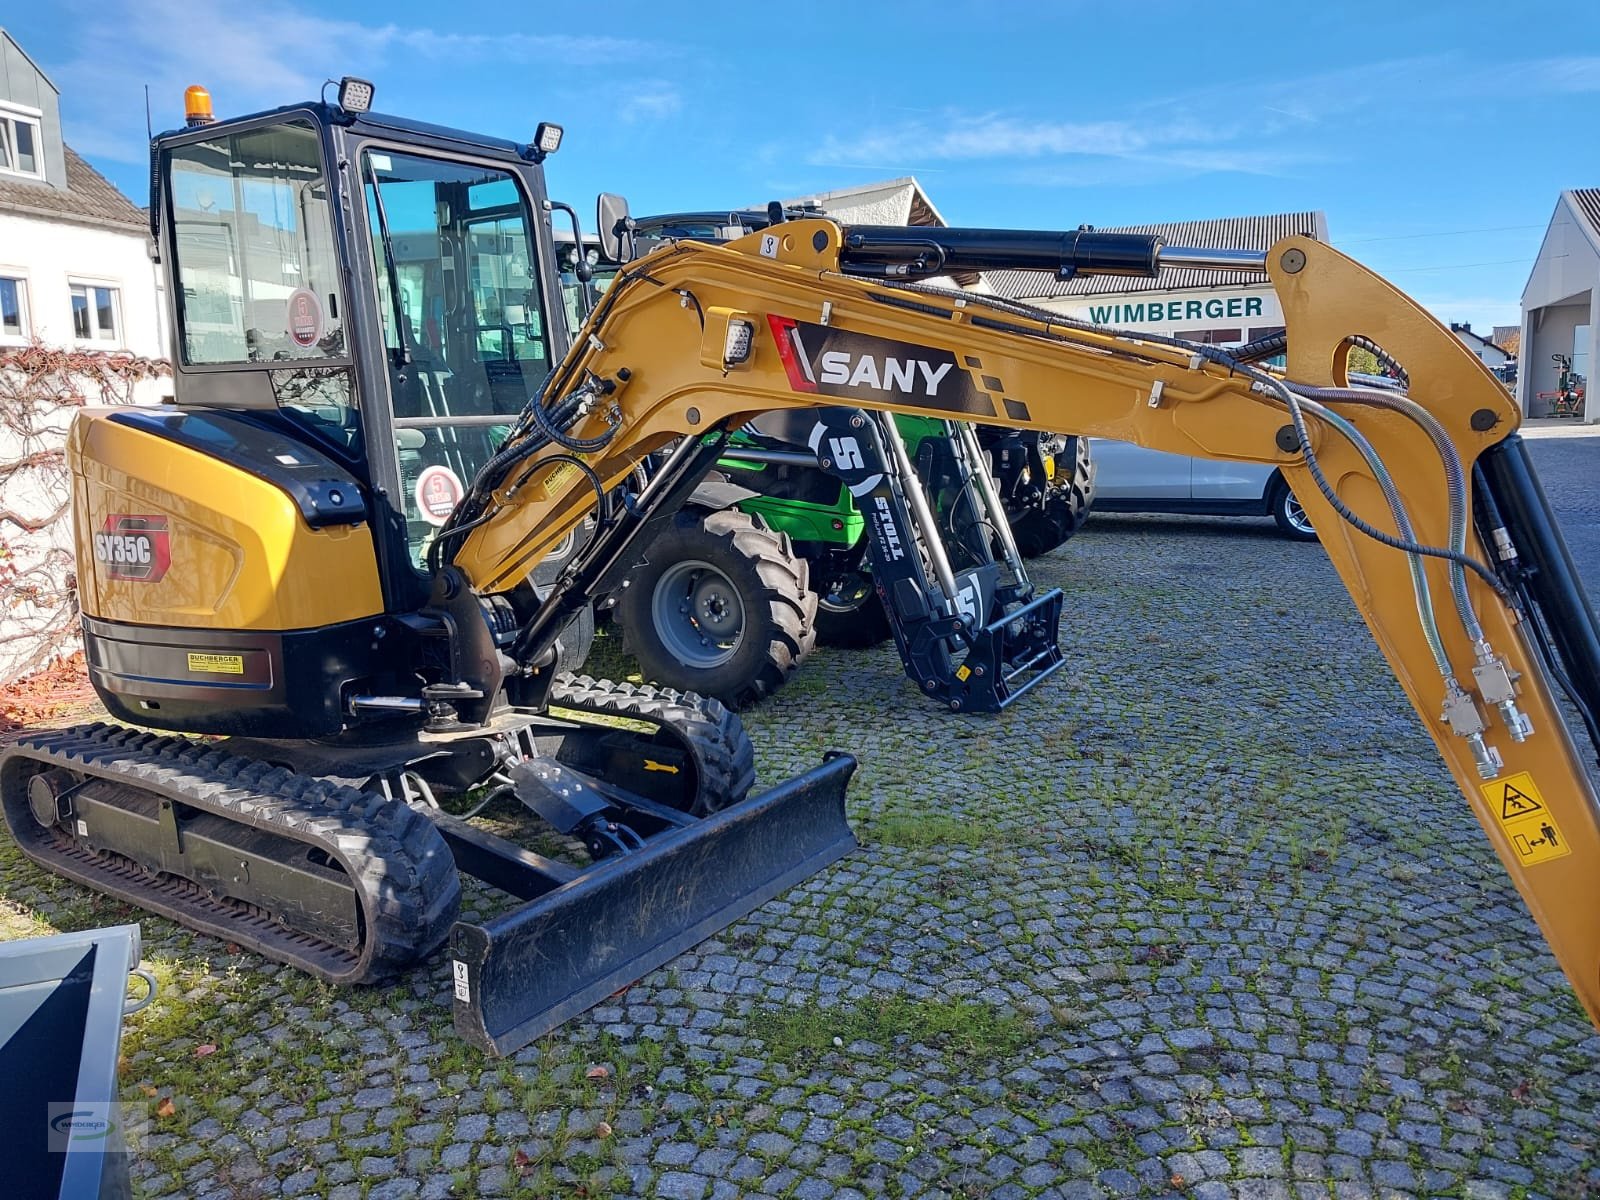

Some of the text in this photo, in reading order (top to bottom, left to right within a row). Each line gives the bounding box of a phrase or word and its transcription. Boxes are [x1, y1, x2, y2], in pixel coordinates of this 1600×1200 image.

[1089, 297, 1263, 324] WIMBERGER
[820, 351, 954, 396] SANY
[431, 475, 443, 493] 5
[874, 496, 905, 561] STOLL
[95, 533, 151, 564] SY35C
